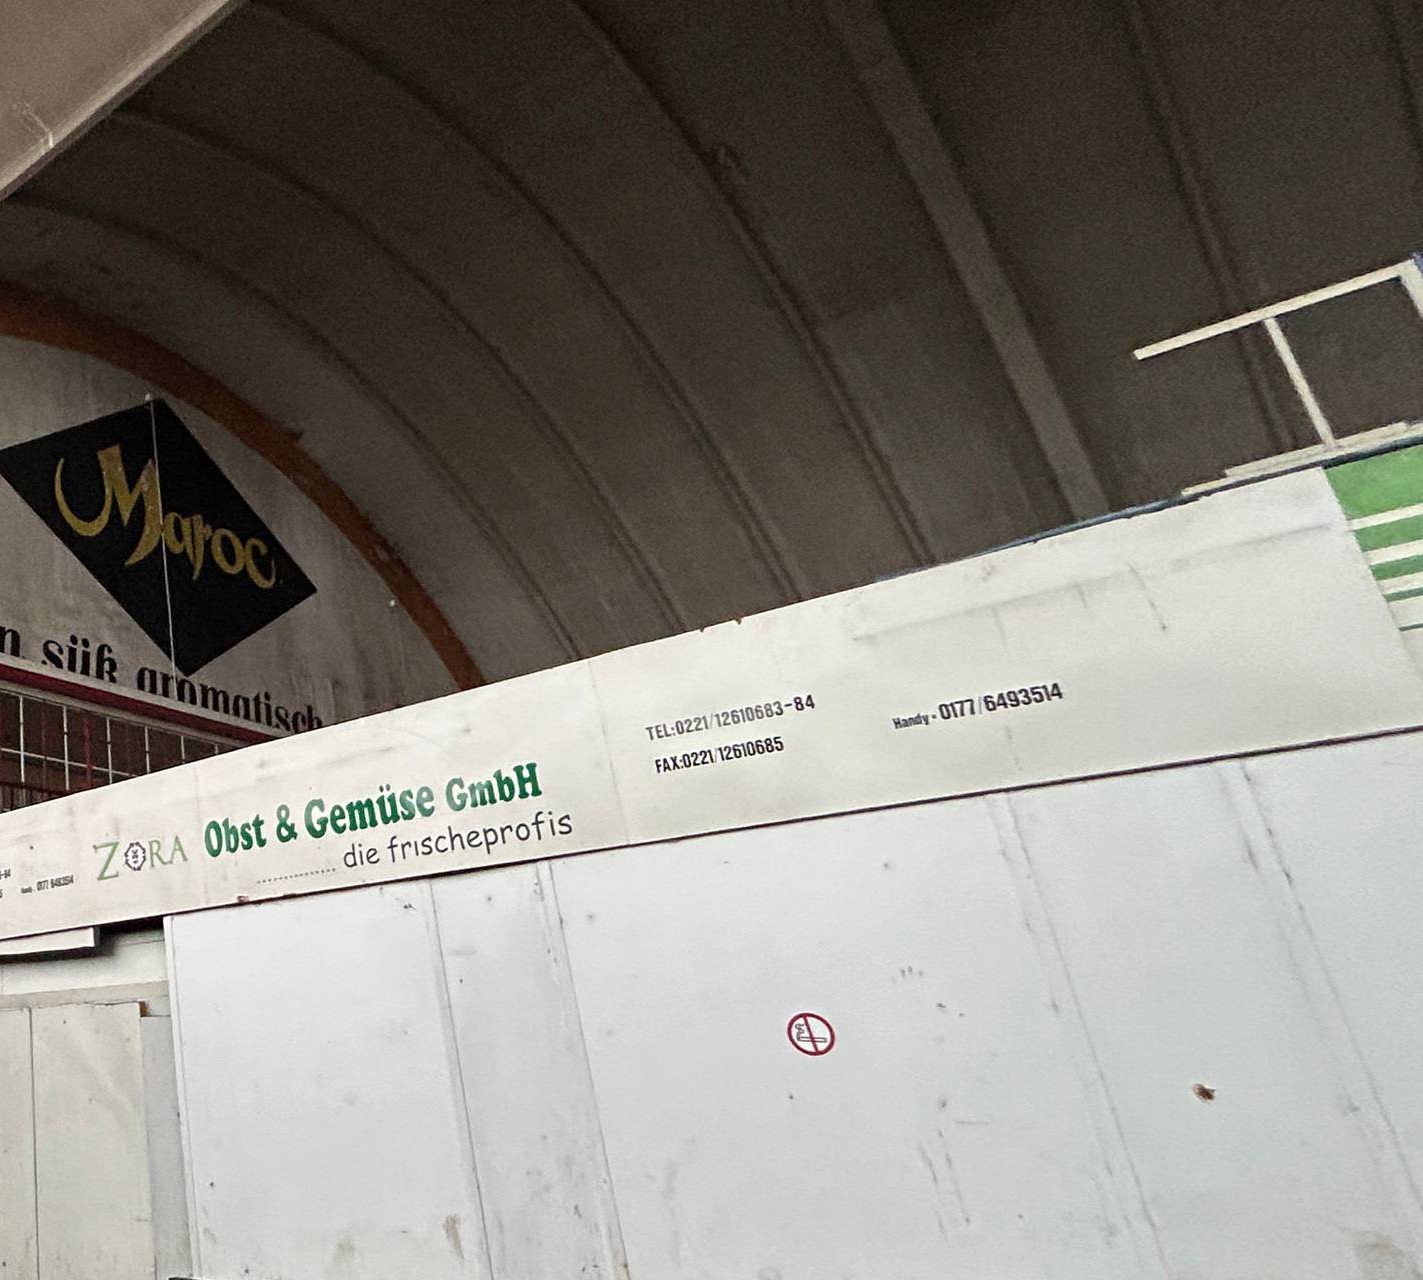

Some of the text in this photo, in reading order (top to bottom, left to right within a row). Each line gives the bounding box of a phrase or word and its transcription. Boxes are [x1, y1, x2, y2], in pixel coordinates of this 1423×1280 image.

[55, 444, 276, 589] Maroc
[645, 694, 815, 741] TEL:0221/12610683-84
[892, 713, 929, 730] Handy
[938, 682, 1063, 721] 0177/6493514
[655, 736, 785, 773] FAX:0221/12610685
[204, 761, 542, 858] Obst & Gemüse GmbH
[93, 834, 188, 881] ZORA
[343, 809, 573, 869] die frischeprofis
